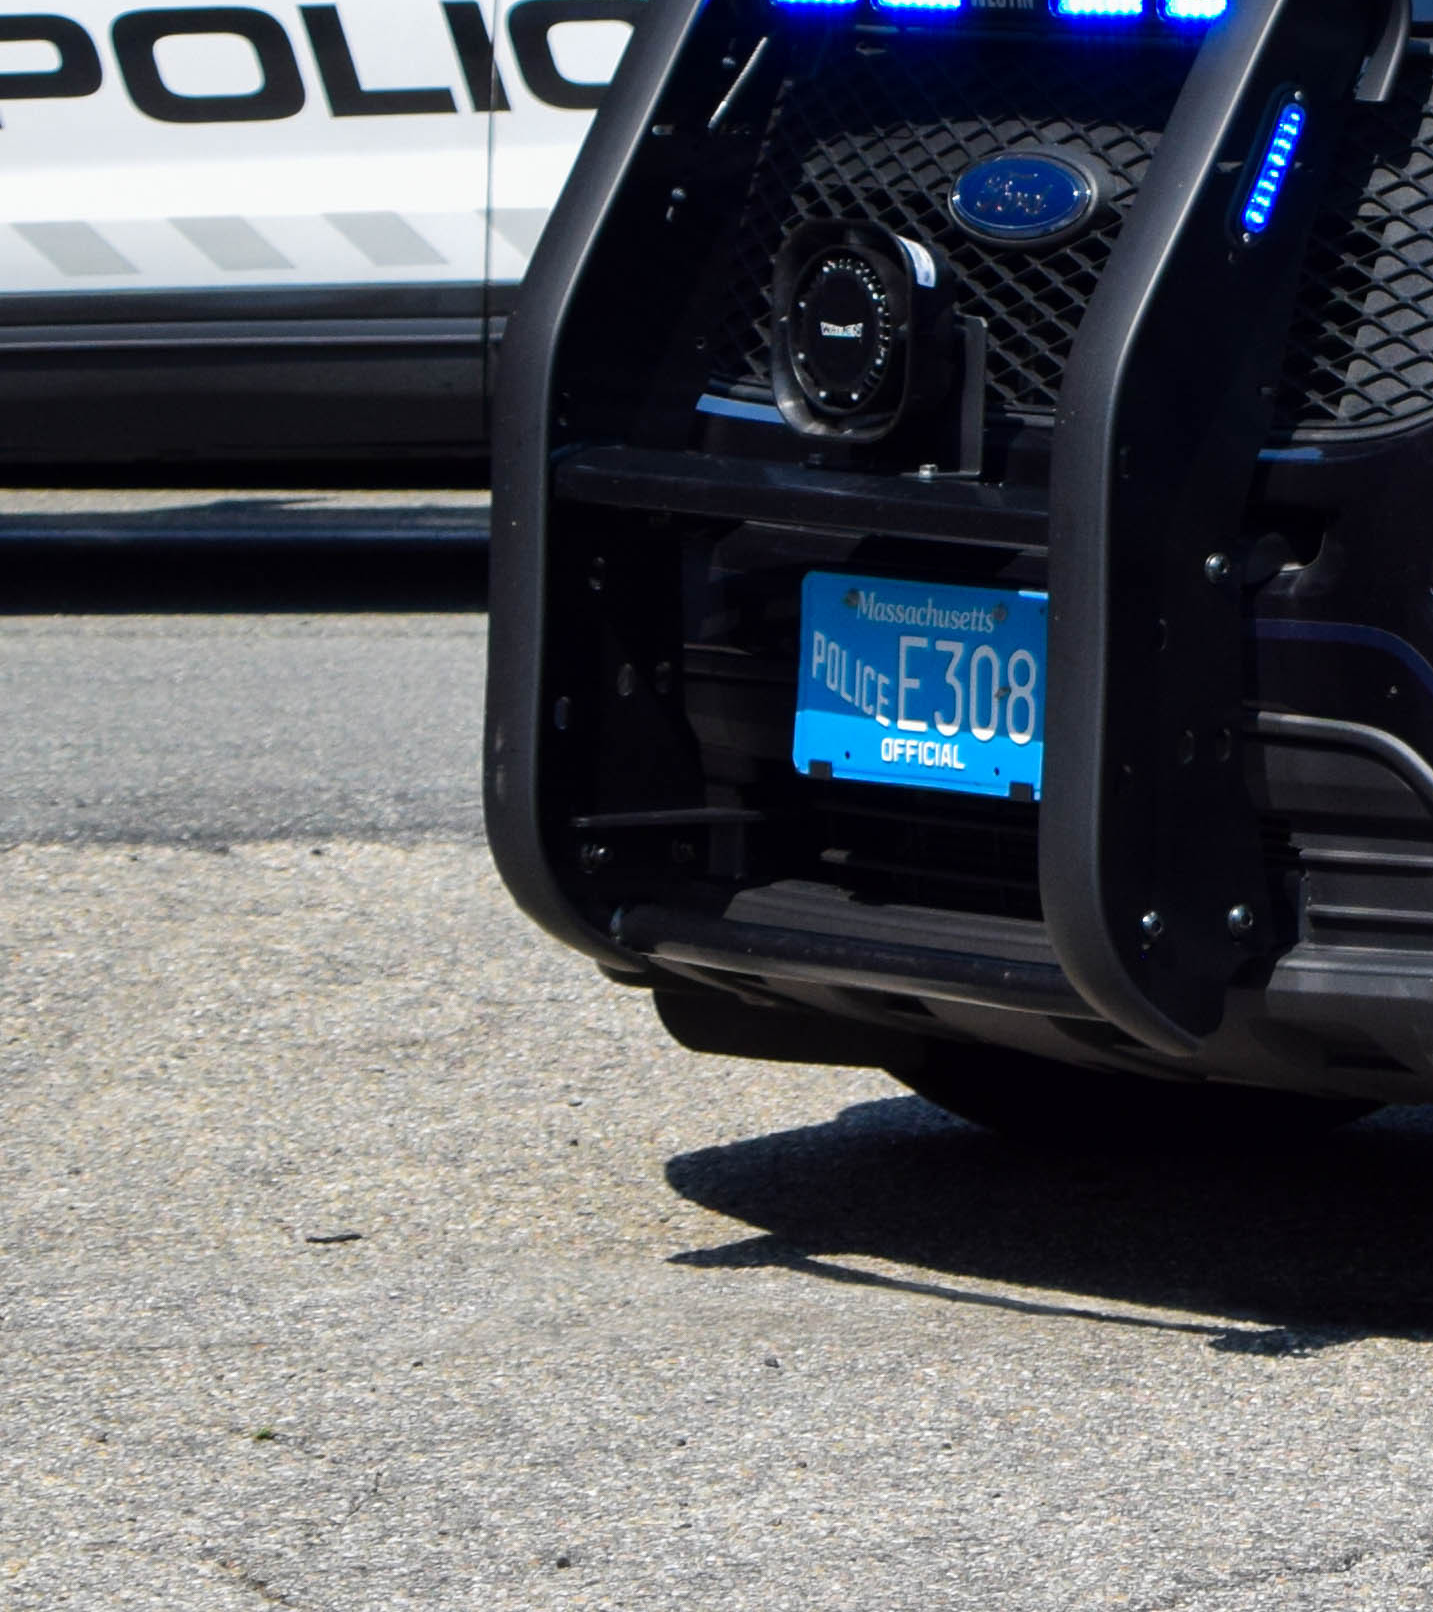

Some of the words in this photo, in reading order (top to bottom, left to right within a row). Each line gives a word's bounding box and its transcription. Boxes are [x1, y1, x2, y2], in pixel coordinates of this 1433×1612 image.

[857, 591, 995, 633] Massachusetts
[812, 631, 891, 728] POLICE
[896, 635, 1037, 745] E308
[881, 738, 966, 770] OFFICIAL
